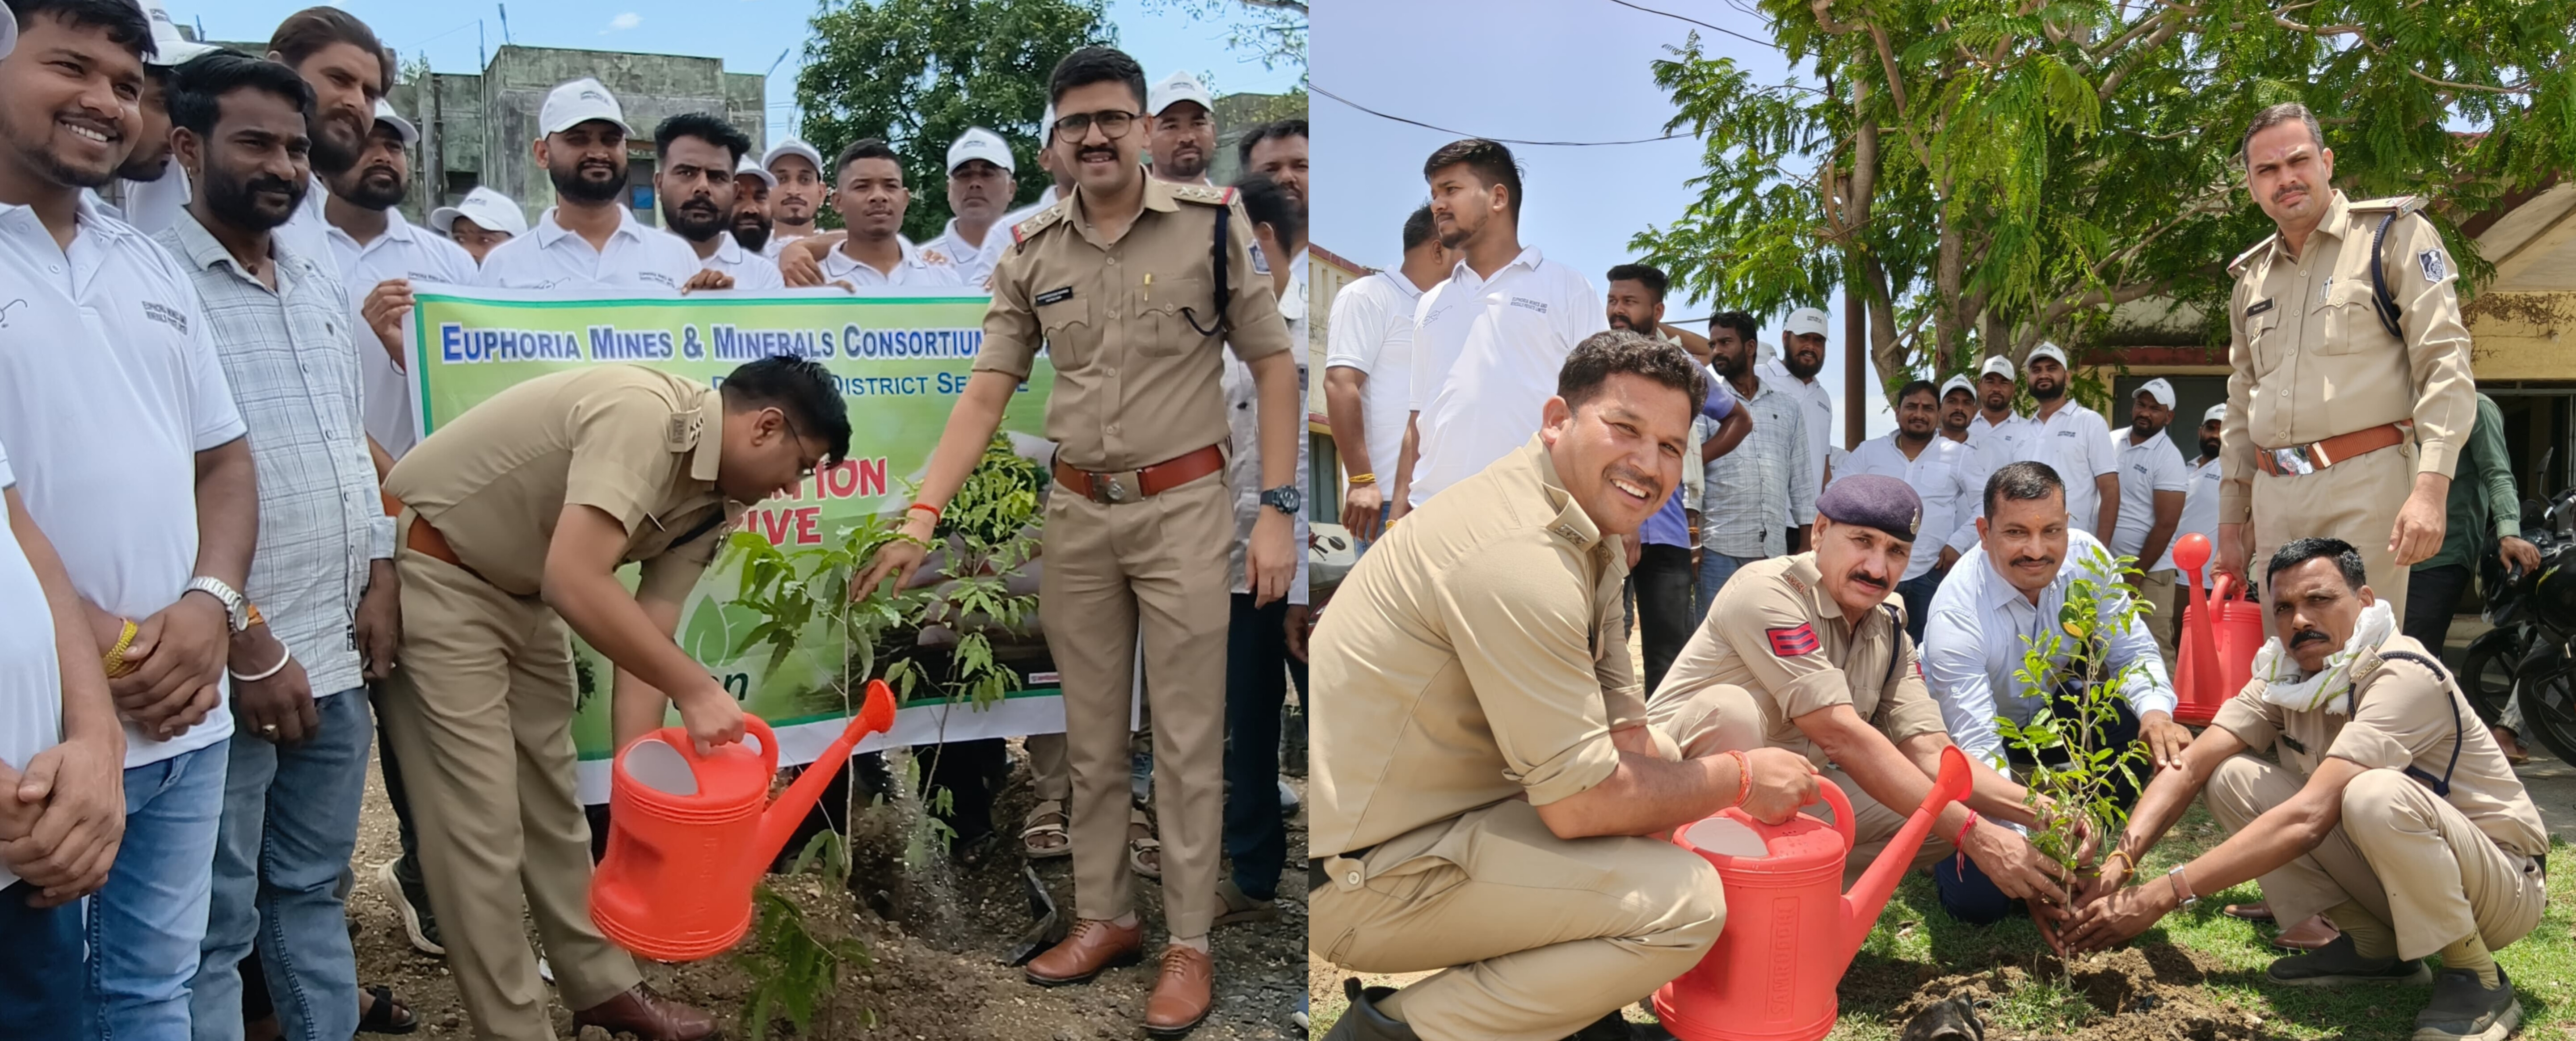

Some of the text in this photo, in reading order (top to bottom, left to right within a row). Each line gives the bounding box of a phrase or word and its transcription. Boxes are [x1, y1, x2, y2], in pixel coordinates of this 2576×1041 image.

[442, 324, 582, 361] EUPHORIA
[589, 327, 673, 360] MINES
[683, 327, 705, 359] &
[712, 327, 835, 358] MINERALS
[1770, 905, 1796, 1015] SAMRUDDHI
